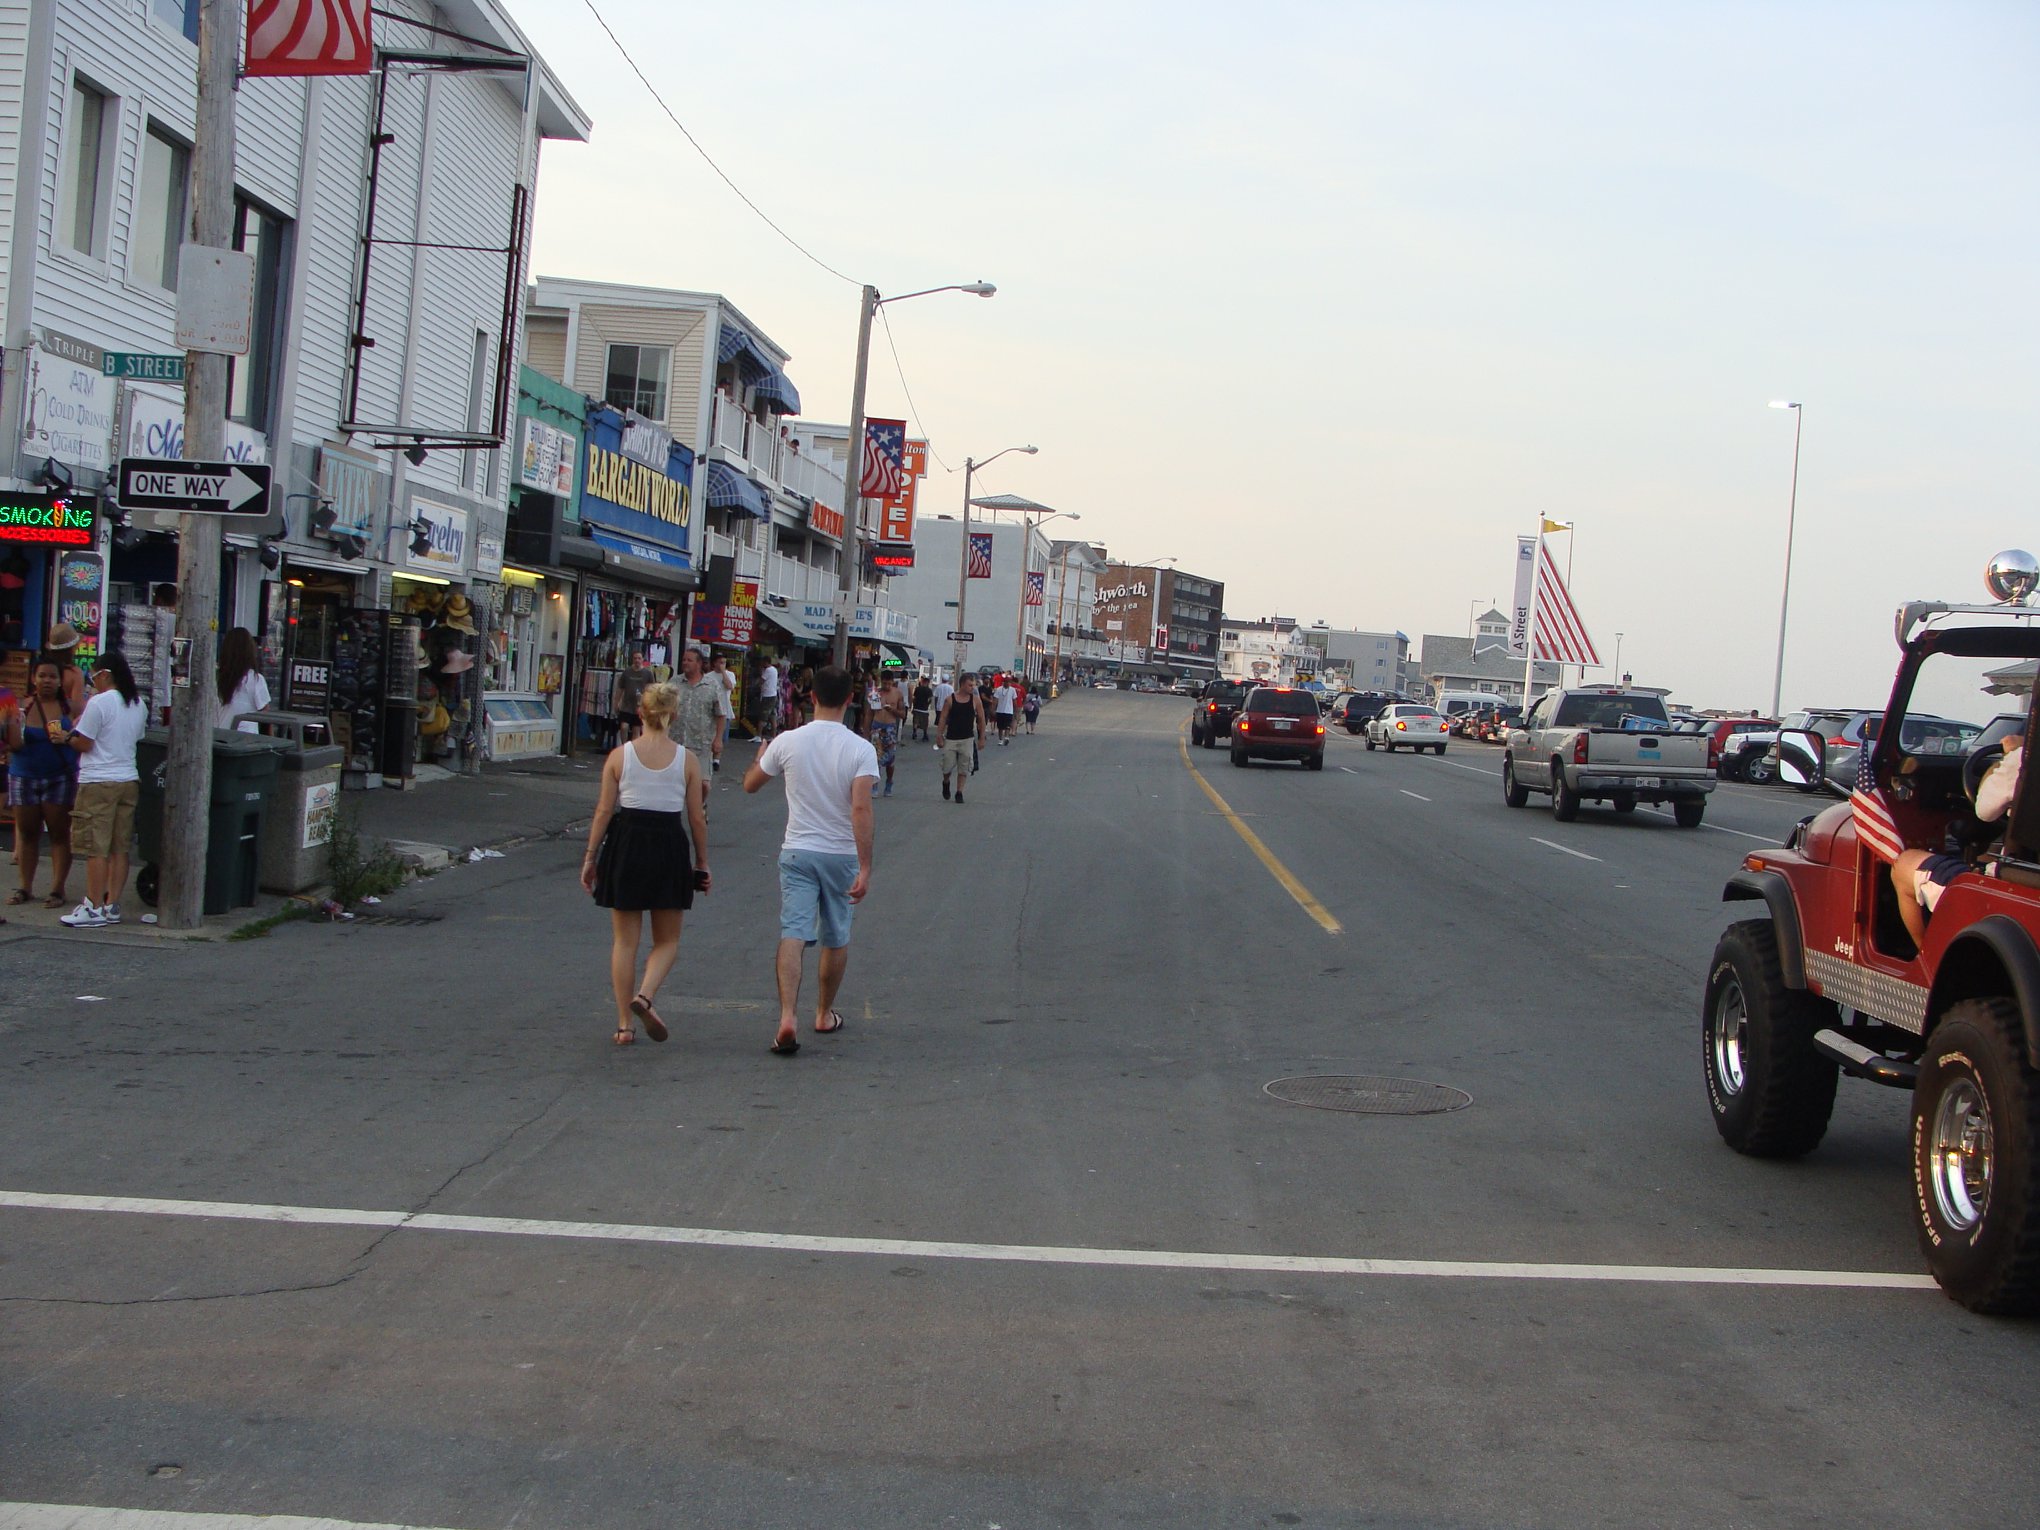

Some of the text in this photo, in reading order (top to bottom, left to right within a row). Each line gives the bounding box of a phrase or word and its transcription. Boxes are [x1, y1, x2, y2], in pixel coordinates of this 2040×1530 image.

[54, 336, 95, 364] TRIPLE
[106, 356, 181, 378] B STREET
[69, 370, 96, 397] ATM
[49, 396, 109, 430] COLD DRINKS
[51, 430, 102, 461] CIGARETTES
[904, 443, 925, 455] lton
[135, 474, 226, 497] ONE WAY
[587, 443, 650, 514] BARGAIN
[651, 472, 690, 528] WORLD
[875, 556, 913, 567] VACANCY
[64, 602, 99, 624] YOLO
[724, 605, 753, 620] HENNA
[804, 605, 826, 618] MAD
[1107, 603, 1121, 614] the
[723, 617, 753, 631] TATTOOS
[1513, 607, 1527, 651] A Street
[721, 628, 750, 643] $3
[294, 664, 328, 684] FREE
[1834, 935, 1854, 959] Jeep
[1913, 1114, 1942, 1247] BFGoodrich
